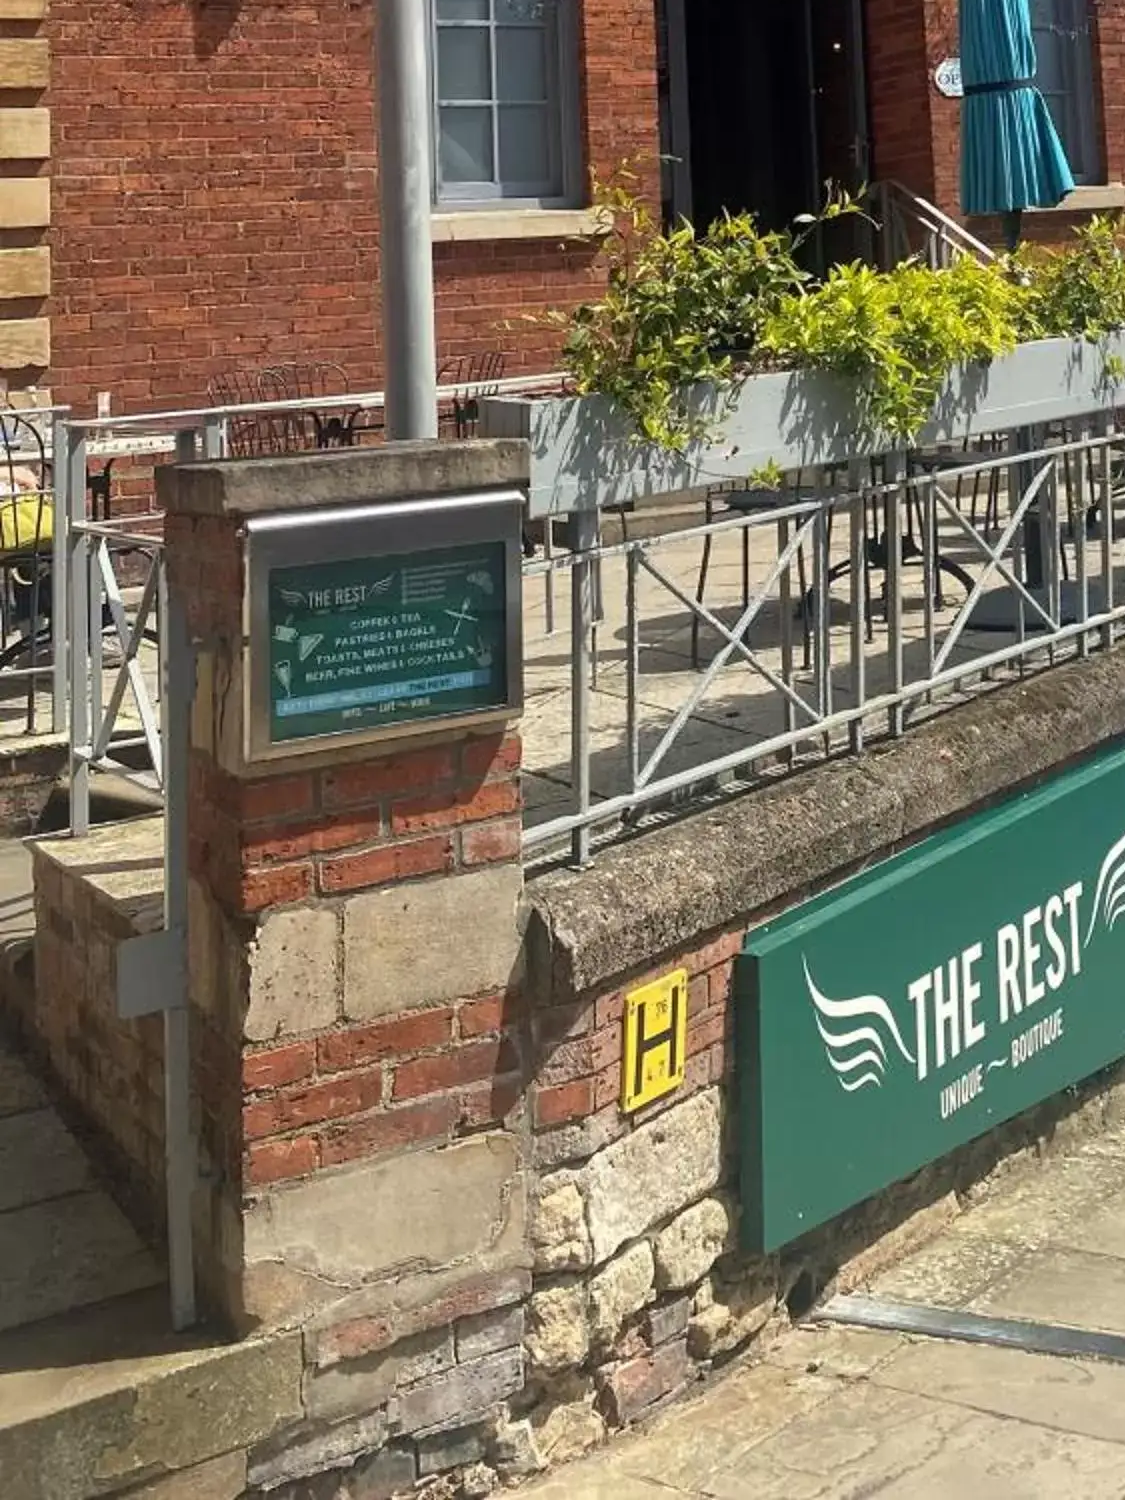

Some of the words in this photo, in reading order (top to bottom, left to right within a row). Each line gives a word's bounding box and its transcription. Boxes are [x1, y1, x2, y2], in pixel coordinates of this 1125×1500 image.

[307, 589, 332, 608] THE
[335, 585, 367, 605] REST
[401, 612, 421, 623] TEA
[908, 942, 985, 1082] THE
[997, 882, 1083, 1023] REST
[634, 985, 679, 1097] H
[940, 1064, 984, 1119] UNIQUE
[1011, 1008, 1063, 1068] BOUTIQUE
